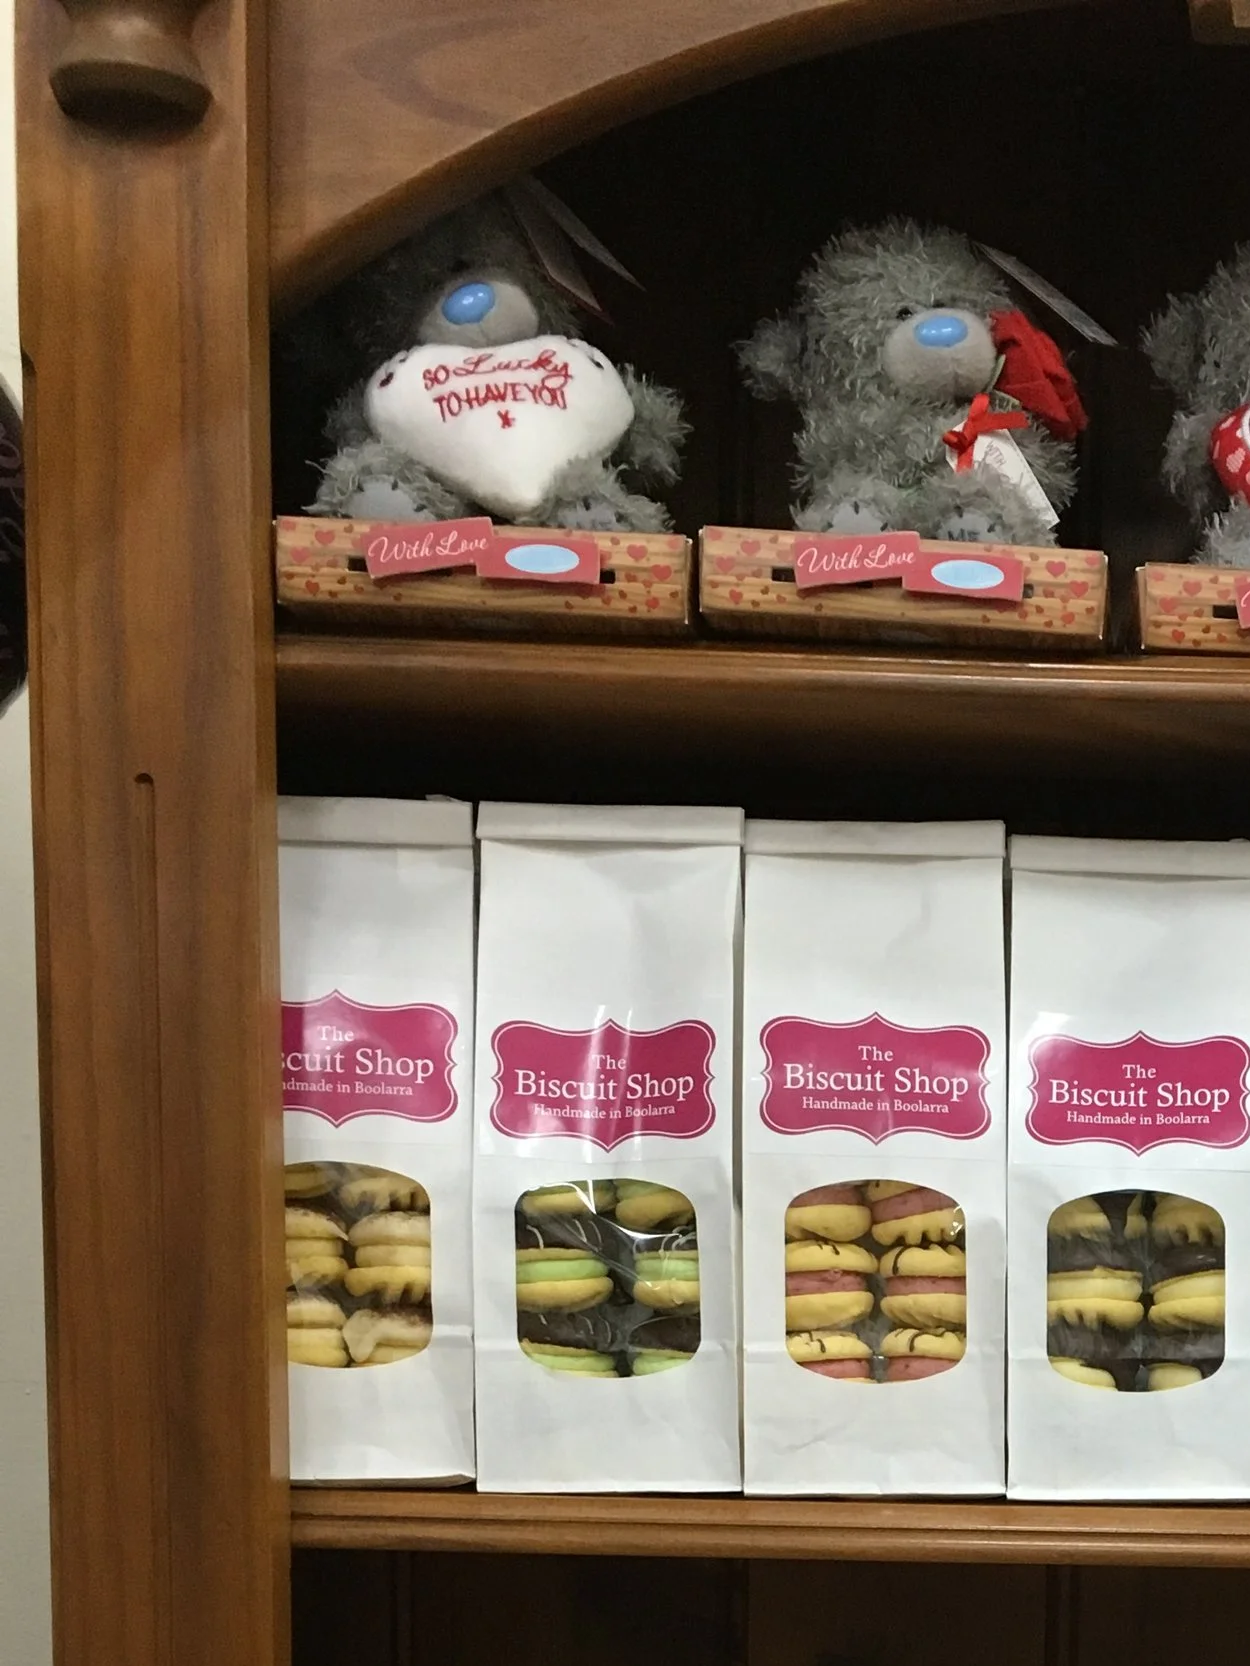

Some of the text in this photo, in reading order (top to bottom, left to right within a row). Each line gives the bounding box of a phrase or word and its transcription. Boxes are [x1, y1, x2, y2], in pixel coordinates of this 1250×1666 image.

[423, 350, 572, 390] SO Lucky
[433, 383, 568, 422] TO HAVE YOU
[368, 531, 489, 563] With Love
[797, 544, 916, 573] With Love
[317, 1026, 354, 1041] The
[592, 1054, 626, 1070] The
[858, 1045, 893, 1062] The
[355, 1048, 434, 1083] Shop
[1122, 1063, 1156, 1080] The
[337, 1081, 413, 1096] in Boolarra
[514, 1070, 695, 1101] Biscuit Shop
[783, 1062, 969, 1101] Biscuit Shop
[802, 1097, 949, 1114] Handmade in Boolarra
[1049, 1079, 1230, 1112] Biscuit Shop
[534, 1103, 675, 1119] Handmade in Boolarra
[1067, 1111, 1210, 1126] Handmade in Boolarra
